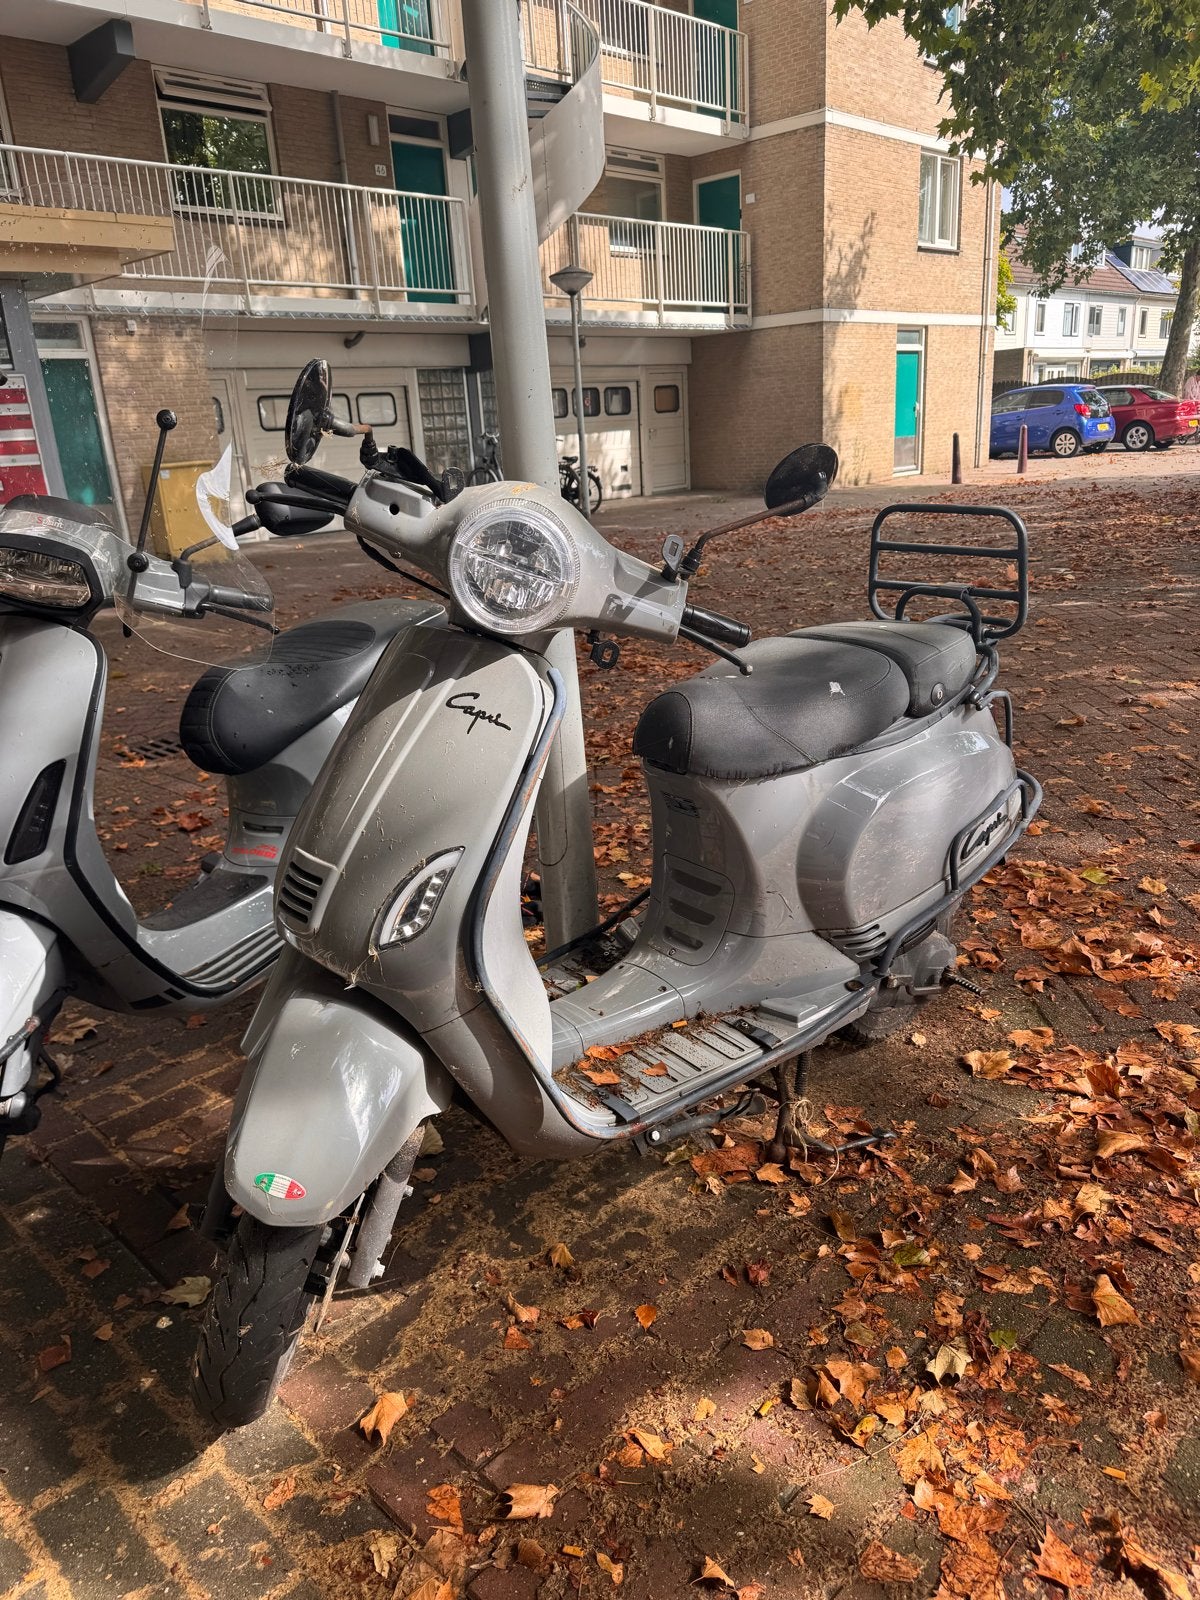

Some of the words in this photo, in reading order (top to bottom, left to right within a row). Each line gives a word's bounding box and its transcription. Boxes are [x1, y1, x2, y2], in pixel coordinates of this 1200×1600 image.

[376, 165, 386, 175] 46
[446, 692, 512, 735] Capri
[960, 811, 1008, 860] Capri
